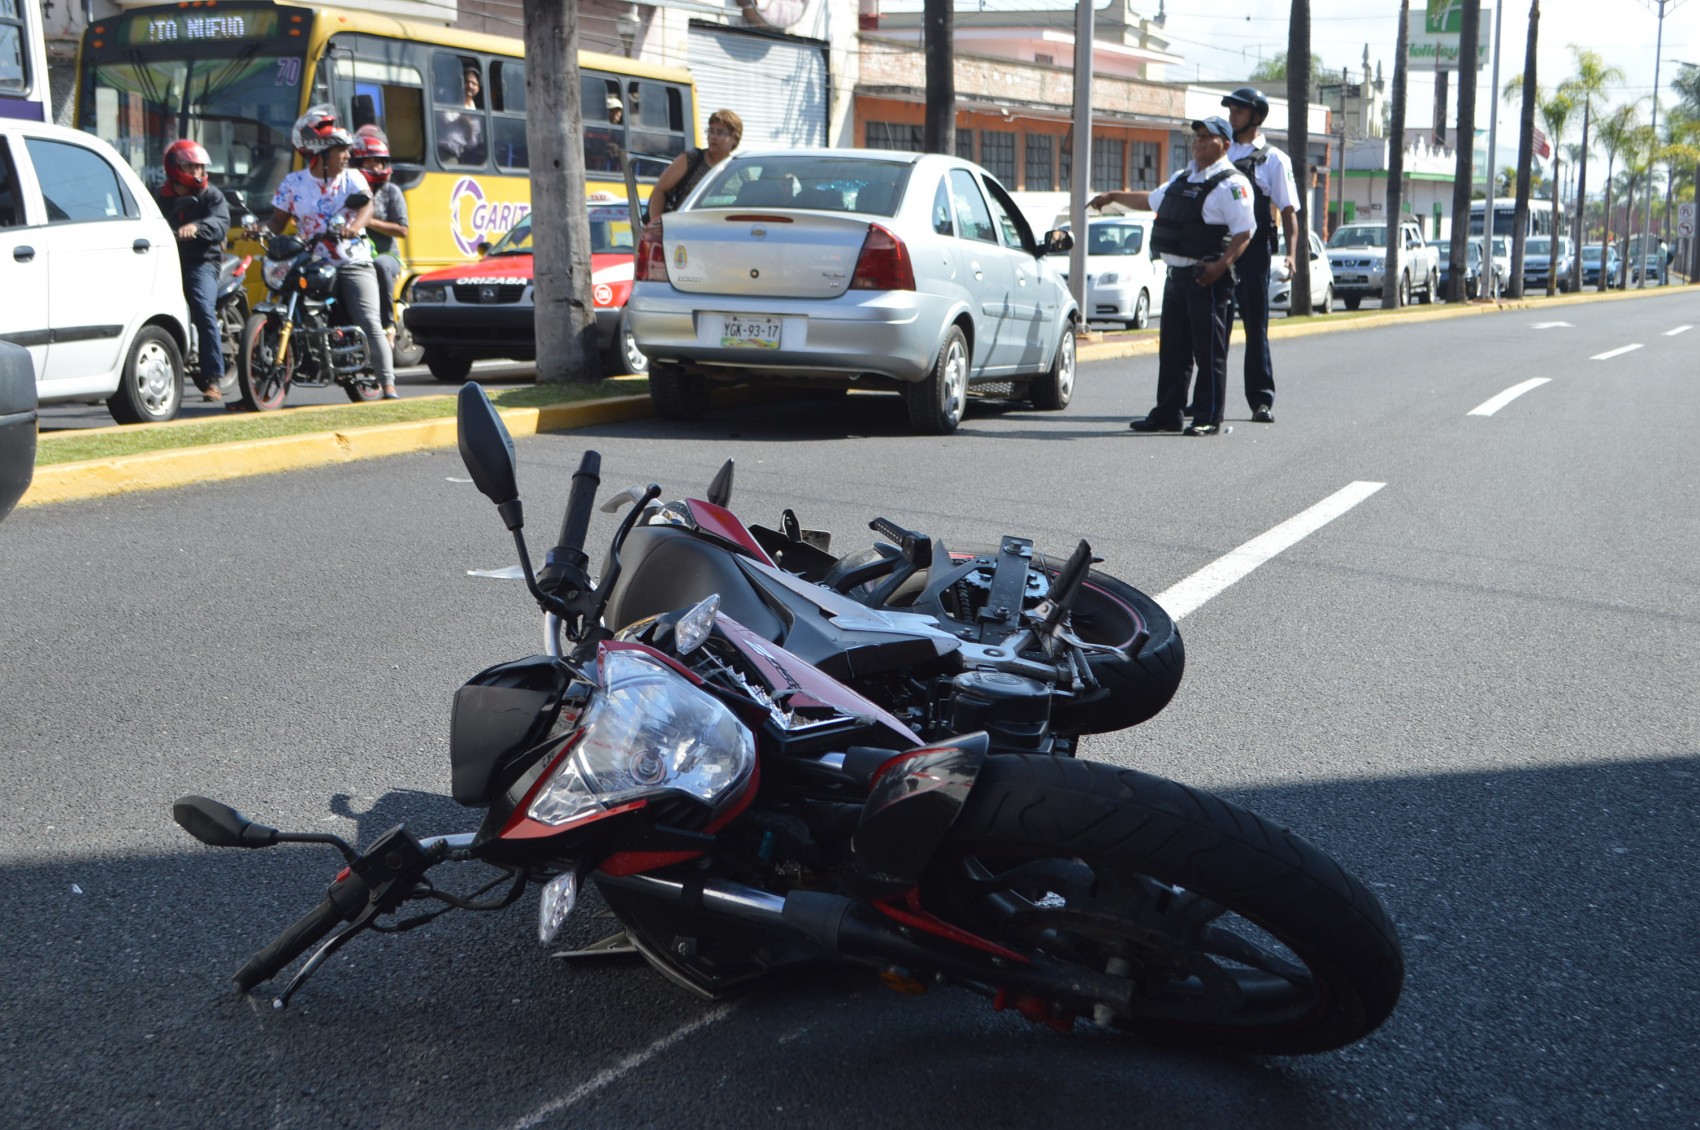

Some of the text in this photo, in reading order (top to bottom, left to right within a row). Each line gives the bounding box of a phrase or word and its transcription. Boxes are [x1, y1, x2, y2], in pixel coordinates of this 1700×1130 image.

[276, 57, 301, 86] 70
[456, 276, 528, 286] ORIZABA
[724, 322, 779, 338] YGK-93-17
